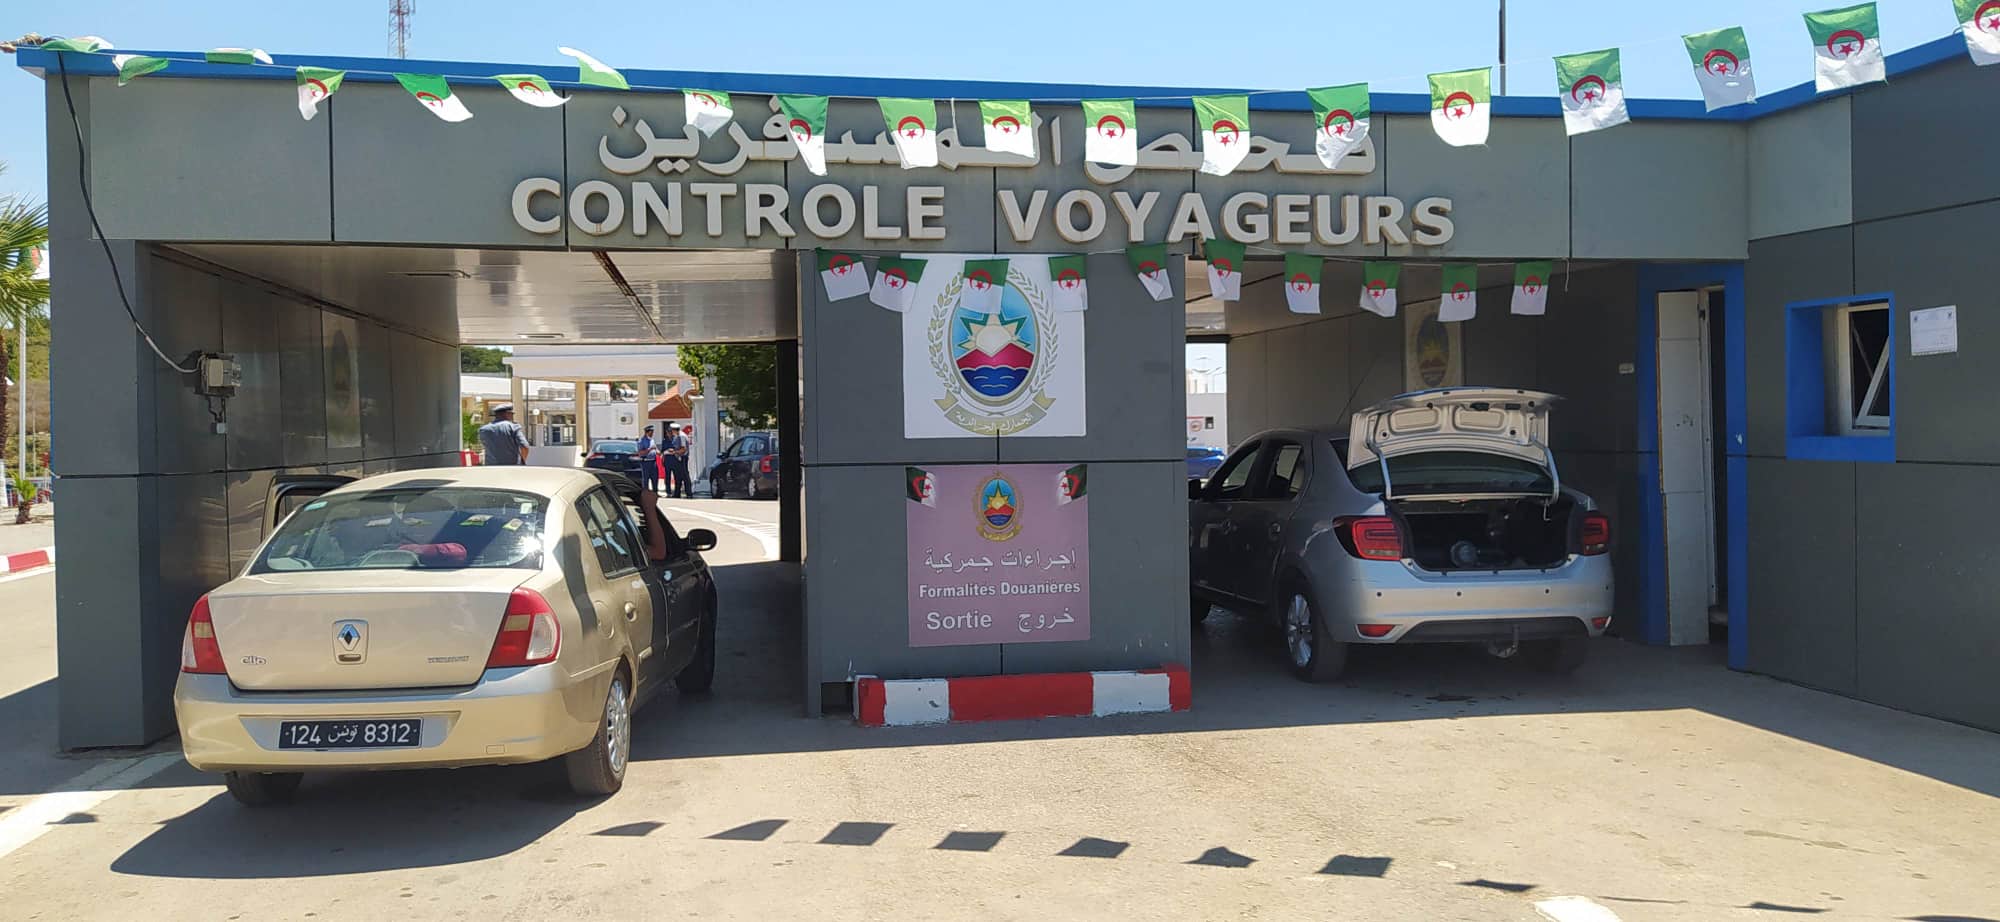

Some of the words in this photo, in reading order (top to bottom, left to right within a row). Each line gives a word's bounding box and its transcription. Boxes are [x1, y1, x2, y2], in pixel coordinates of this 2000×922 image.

[511, 177, 946, 241] CONTROLE
[998, 189, 1455, 246] VOYAGEURS
[924, 548, 994, 574] جمركية
[926, 610, 993, 631] Sortie
[1018, 607, 1075, 633] خروج
[291, 725, 321, 744] 124
[364, 723, 411, 743] 8312
